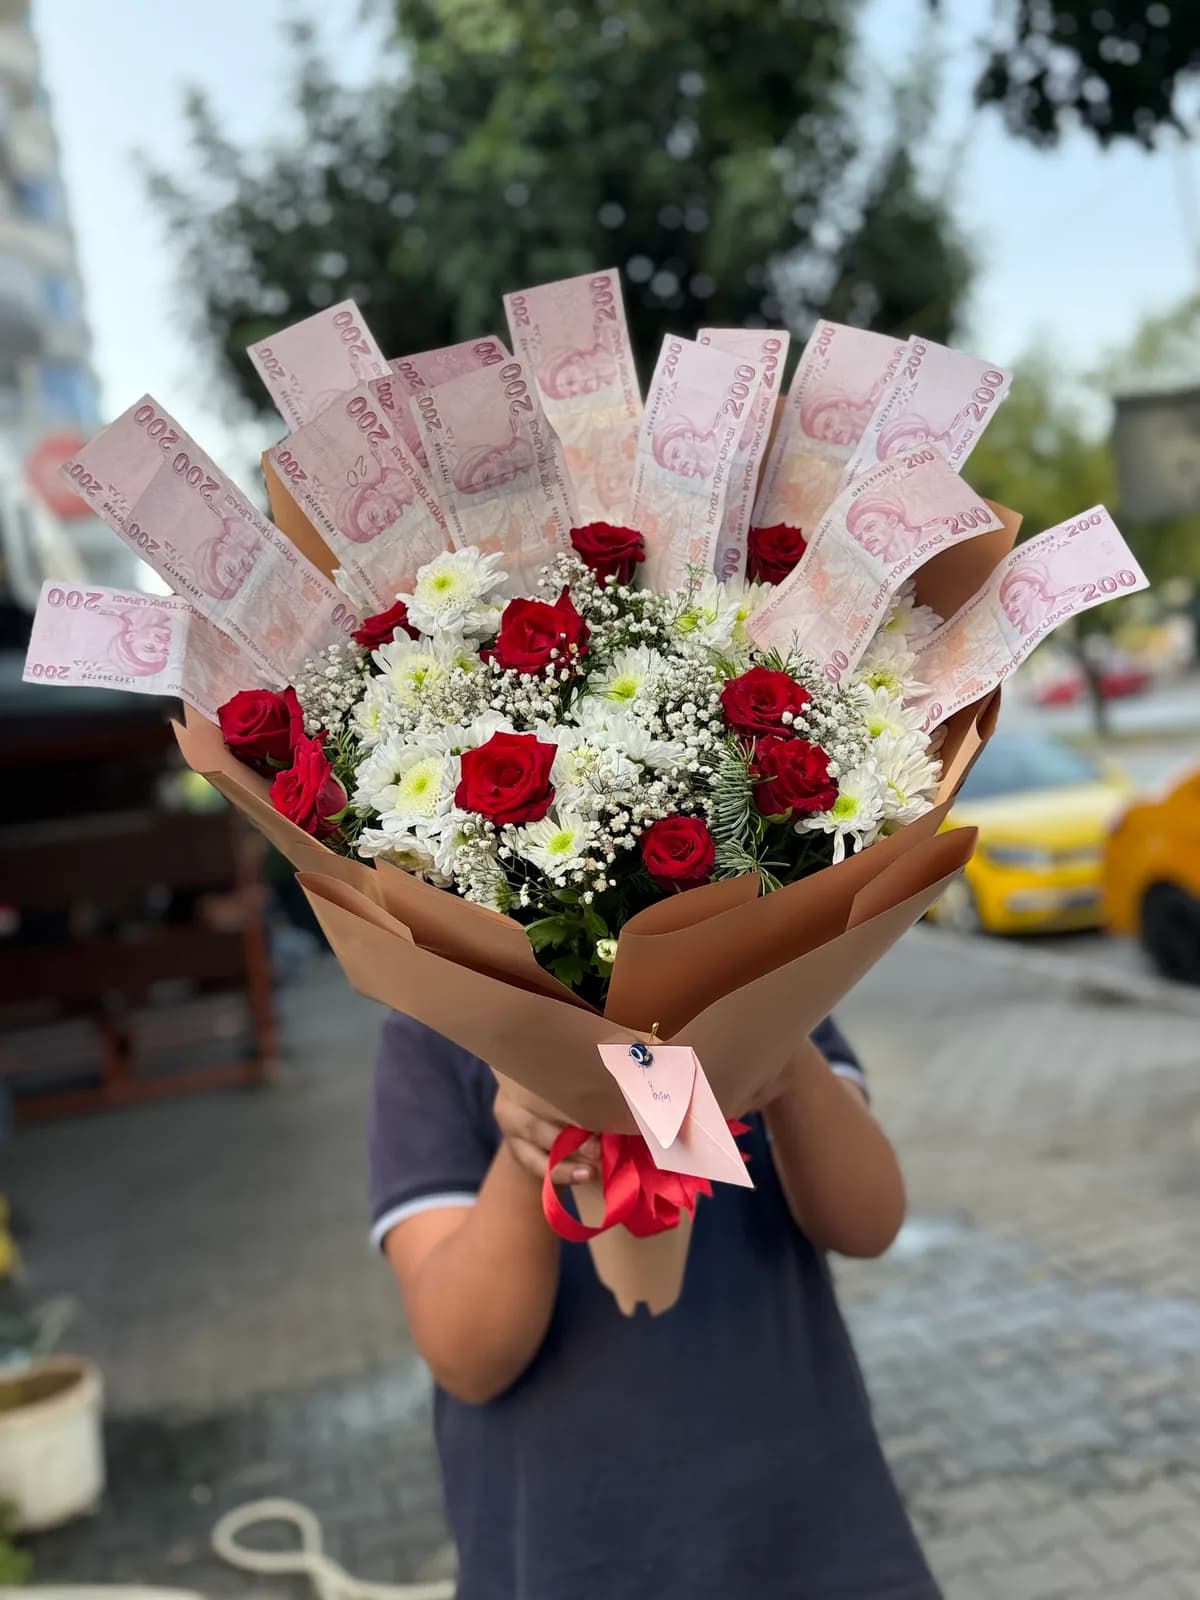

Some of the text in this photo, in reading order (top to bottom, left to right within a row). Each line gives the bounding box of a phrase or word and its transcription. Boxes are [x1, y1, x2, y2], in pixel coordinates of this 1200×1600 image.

[511, 296, 529, 326] 200
[592, 276, 617, 323] 200
[332, 312, 371, 359] 200
[814, 327, 835, 356] 200
[259, 348, 284, 380] 200
[473, 342, 503, 366] 00
[663, 343, 683, 377] 200
[904, 343, 928, 379] 200
[400, 362, 425, 390] 200
[500, 363, 532, 416] 200
[722, 365, 755, 418] 200
[376, 382, 394, 412] 200
[963, 371, 1003, 422] 200
[134, 405, 178, 450] 200
[346, 397, 389, 448] 200
[419, 398, 442, 432] 200
[277, 451, 307, 485] 200
[904, 450, 934, 469] 200
[70, 464, 103, 496] 200
[172, 453, 220, 500] 200
[944, 508, 992, 536] 200
[1067, 514, 1102, 538] 200
[128, 524, 160, 555] 200
[47, 588, 103, 611] 200
[1080, 569, 1136, 603] 200
[31, 663, 70, 680] 200
[824, 651, 850, 683] 00
